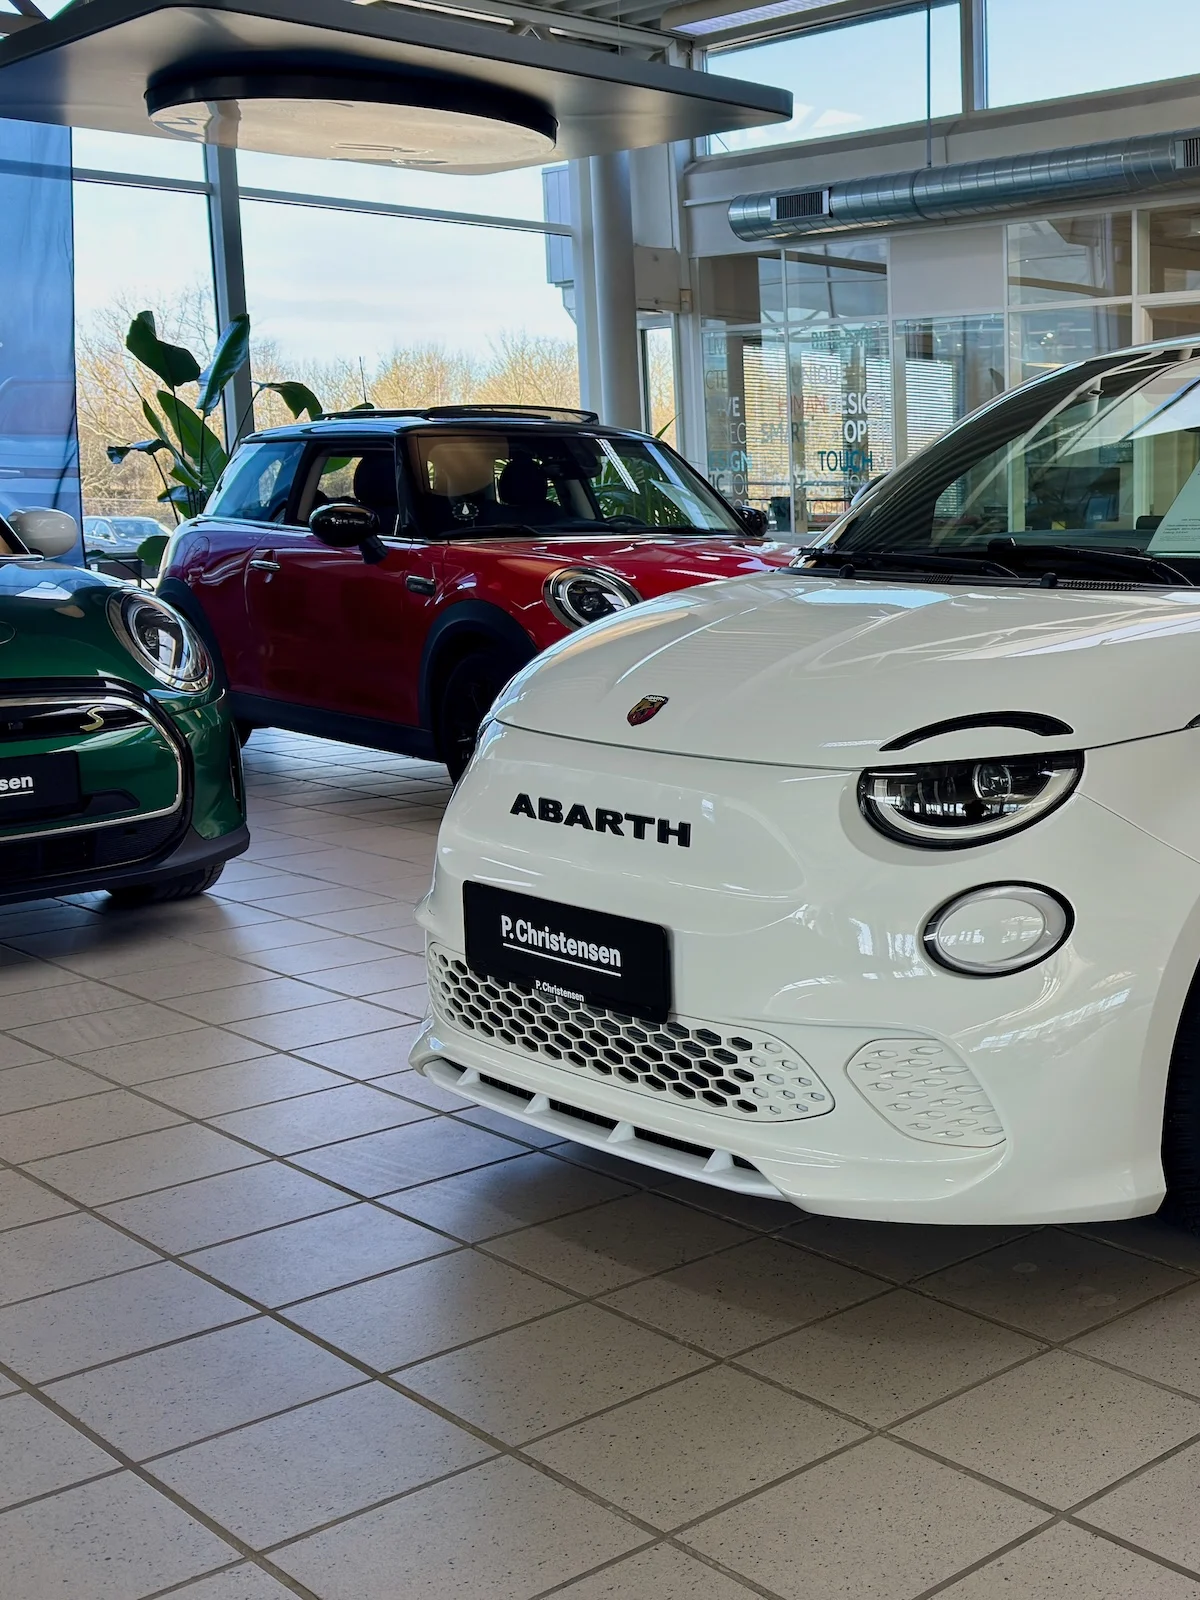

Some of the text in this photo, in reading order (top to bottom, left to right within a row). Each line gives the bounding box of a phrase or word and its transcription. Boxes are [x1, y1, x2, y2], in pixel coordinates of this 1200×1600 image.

[817, 450, 873, 472] TOUCH
[509, 792, 692, 848] ABARTH
[515, 918, 622, 968] Christensen
[542, 982, 585, 1003] Christensen
